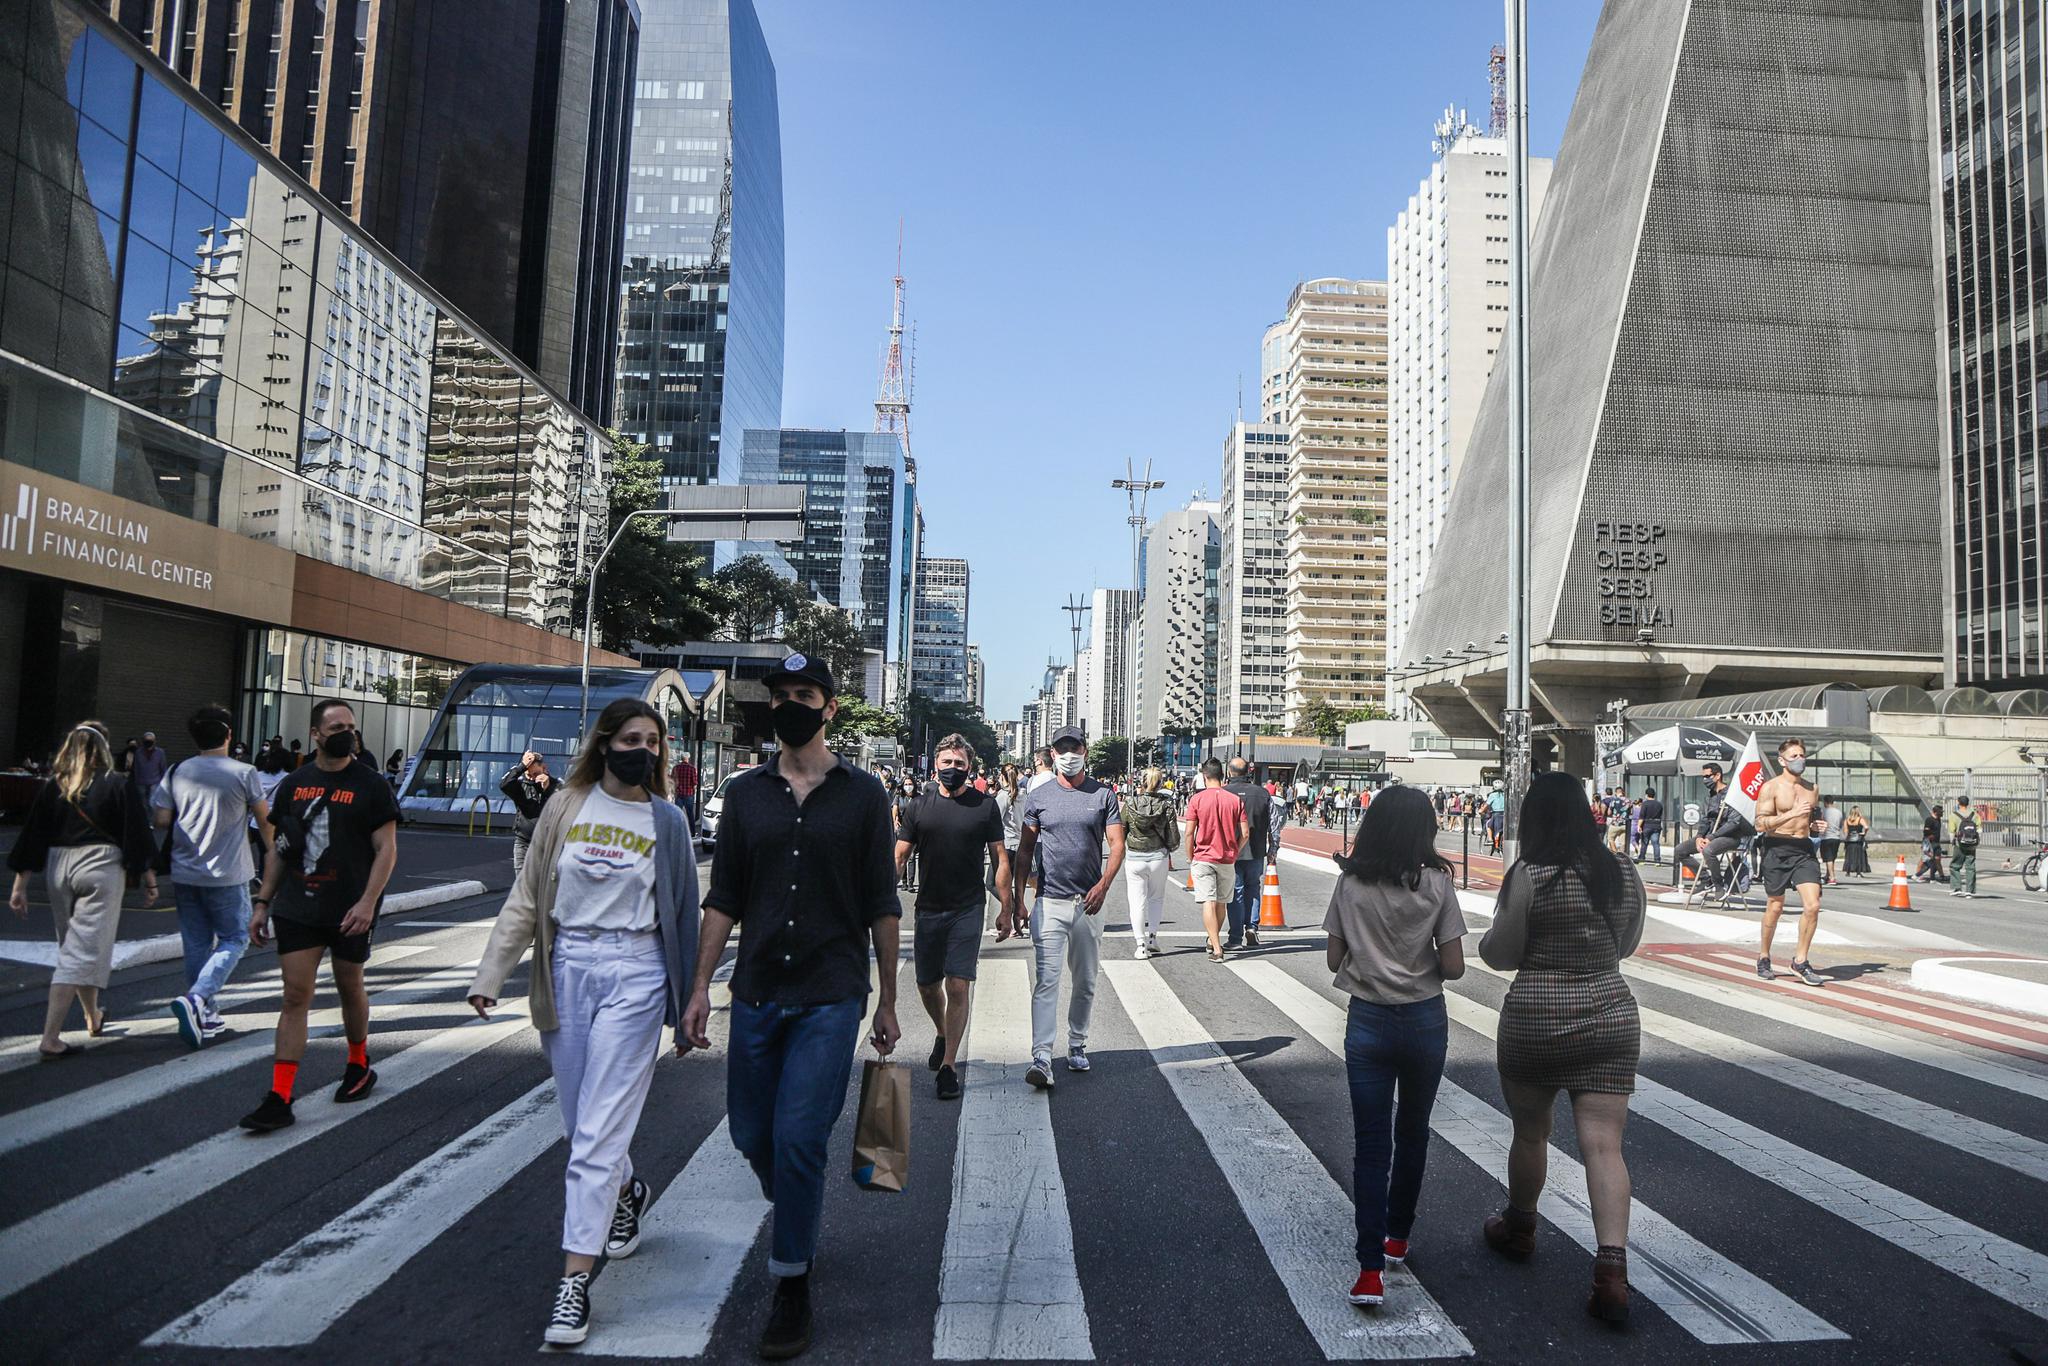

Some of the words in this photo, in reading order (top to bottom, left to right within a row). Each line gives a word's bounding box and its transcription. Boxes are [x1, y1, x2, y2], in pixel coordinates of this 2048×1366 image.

[46, 497, 149, 544] BRAZILIAN
[1594, 521, 1666, 543] FIESP
[43, 531, 147, 576] FINANCIAL
[151, 559, 213, 591] CENTER
[1596, 548, 1668, 571] CIESP
[1600, 575, 1653, 598] SESI
[1684, 737, 1722, 747] Uber
[1637, 750, 1665, 761] Uber
